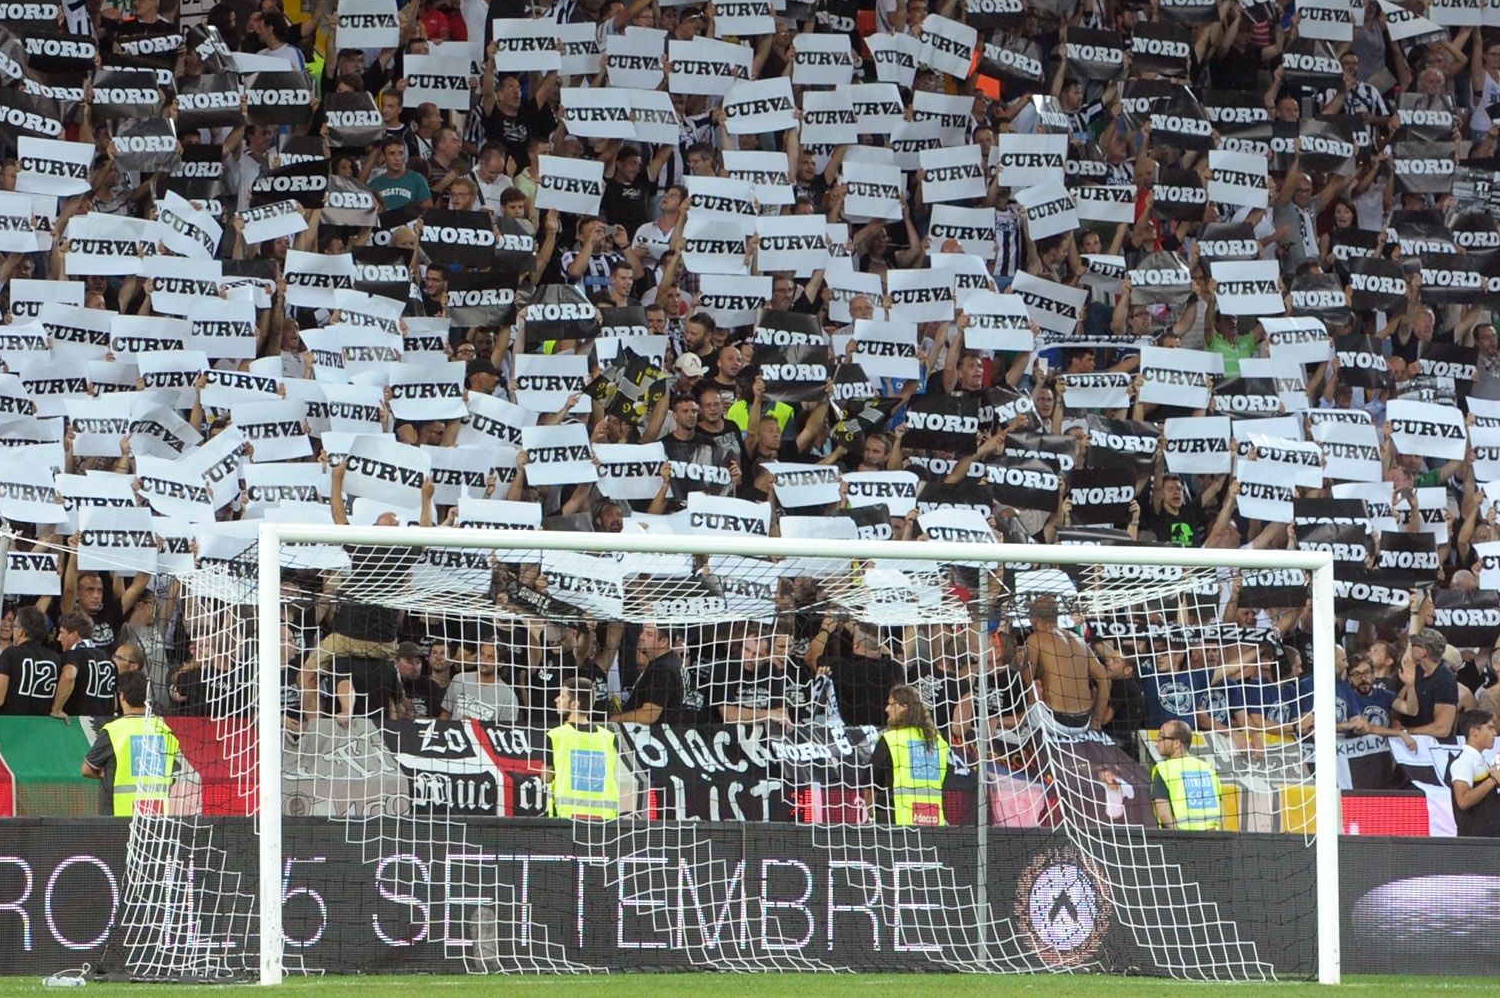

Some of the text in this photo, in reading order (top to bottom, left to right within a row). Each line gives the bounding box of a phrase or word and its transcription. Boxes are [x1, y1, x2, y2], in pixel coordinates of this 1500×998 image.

[966, 0, 1022, 12] NORD
[25, 38, 98, 58] NORD
[1132, 37, 1189, 57] NORD
[724, 97, 793, 117] CURVA
[1205, 107, 1268, 122] NORD
[1150, 114, 1214, 136] NORD
[21, 157, 89, 178] CURVA
[253, 175, 327, 192] NORD
[1212, 168, 1267, 190] CURVA
[421, 226, 494, 246] NORD
[759, 235, 827, 250] CURVA
[931, 224, 995, 243] CURVA
[69, 239, 137, 256] CURVA
[685, 239, 746, 254] CURVA
[1350, 274, 1407, 294] NORD
[447, 289, 514, 306] NORD
[112, 337, 183, 352] CURVA
[205, 371, 280, 394] CURVA
[392, 383, 460, 400] CURVA
[515, 376, 584, 390] CURVA
[907, 411, 978, 433] NORD
[1392, 419, 1465, 439] CURVA
[1088, 427, 1157, 452] NORD
[1167, 438, 1229, 453] CURVA
[526, 445, 590, 465] CURVA
[1257, 444, 1320, 467] CURVA
[347, 455, 424, 489] CURVA
[671, 462, 731, 484] NORD
[847, 482, 916, 497] CURVA
[1071, 486, 1134, 505] NORD
[691, 513, 767, 536] CURVA
[81, 530, 154, 548] CURVA
[1334, 583, 1409, 605] NORD
[18, 658, 57, 698] 12
[280, 856, 328, 947] 5
[372, 854, 943, 953] SETTEMBRE
